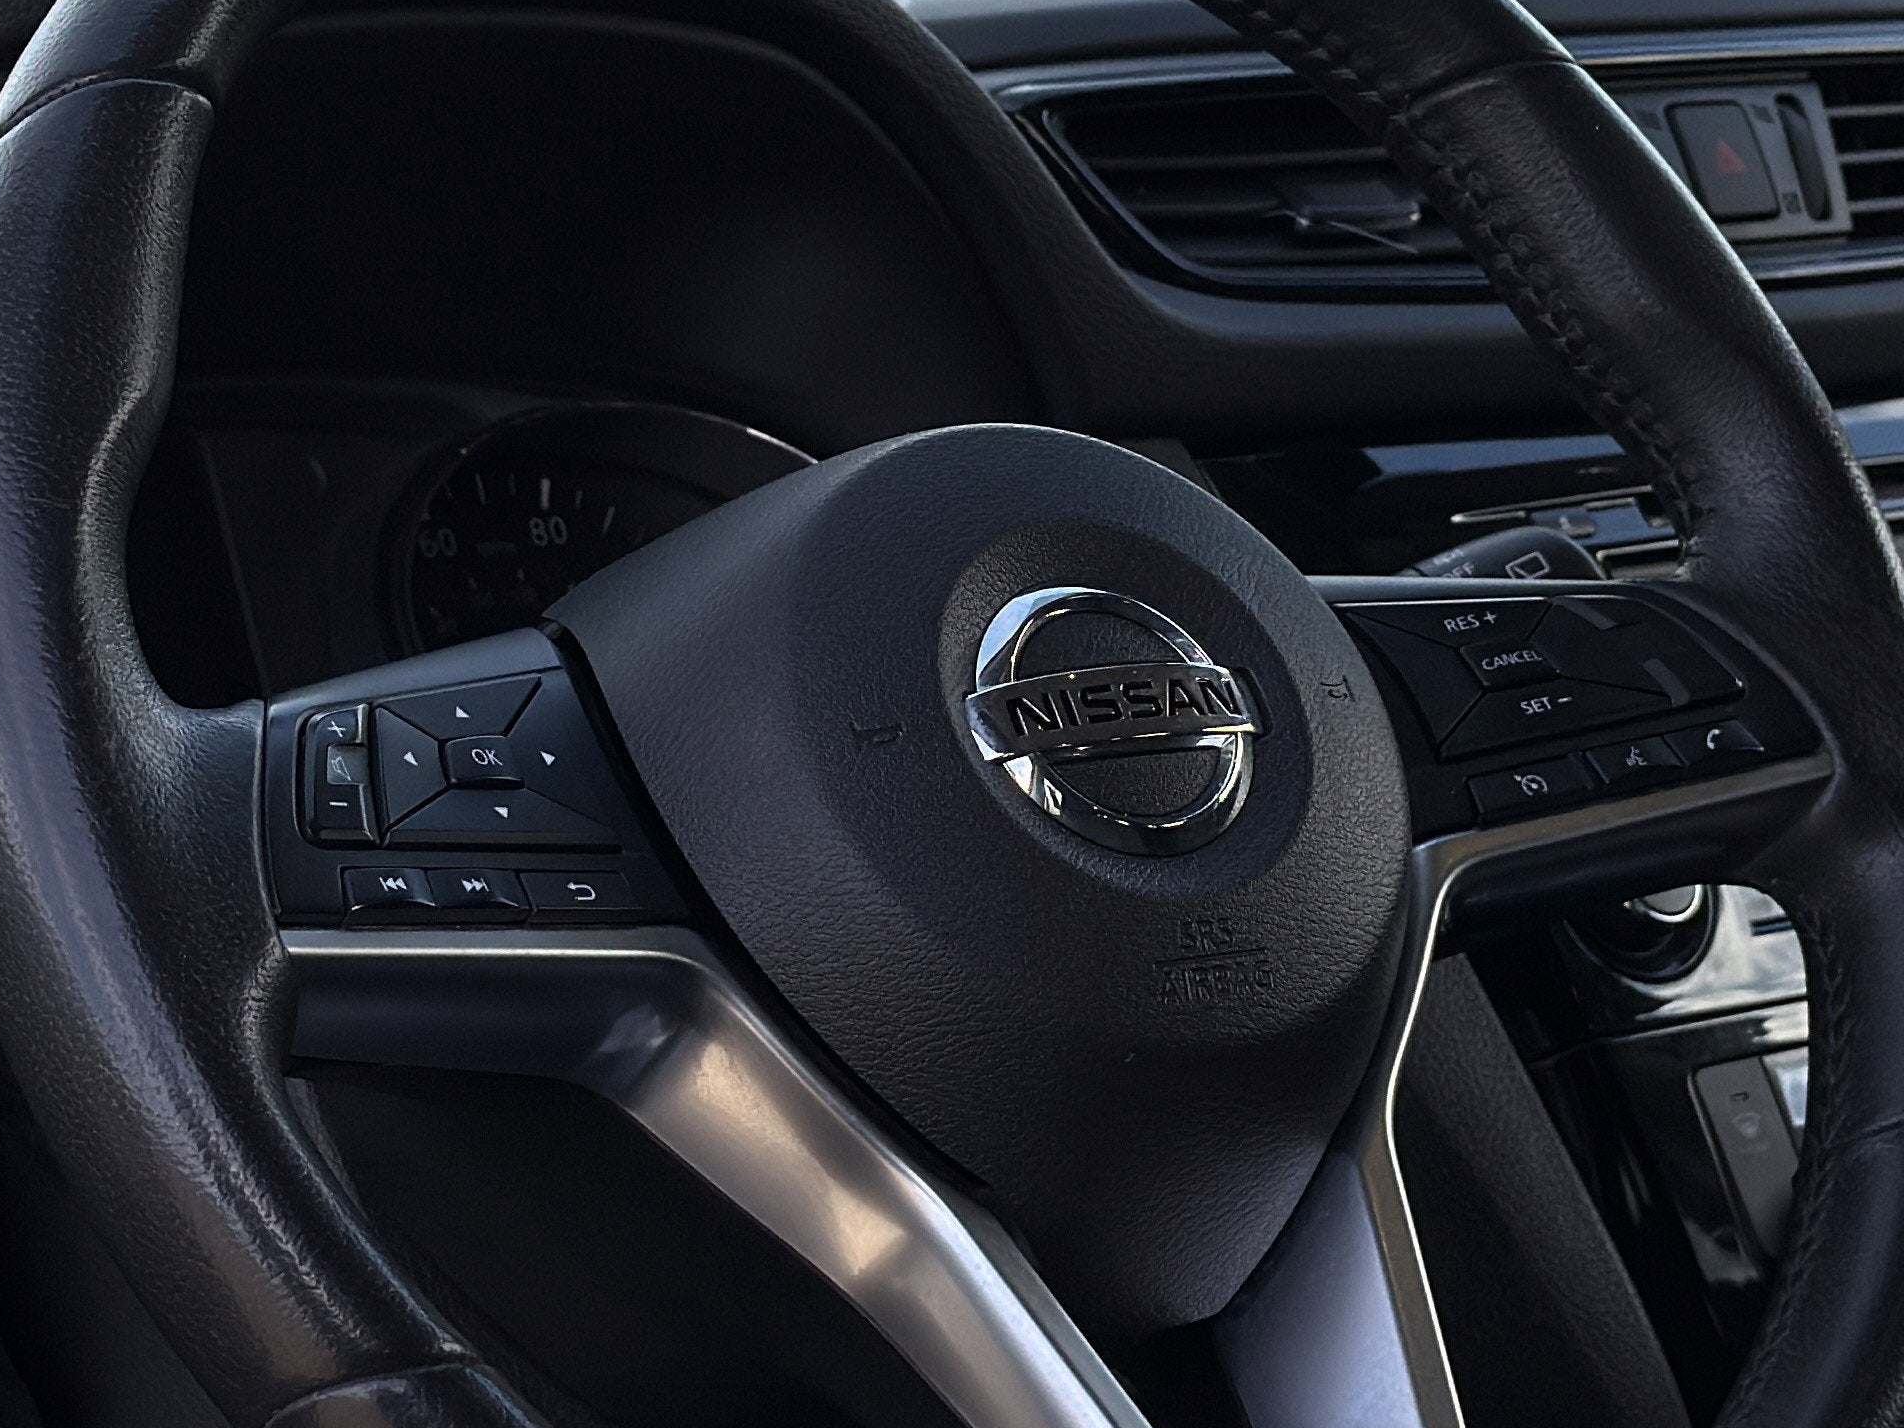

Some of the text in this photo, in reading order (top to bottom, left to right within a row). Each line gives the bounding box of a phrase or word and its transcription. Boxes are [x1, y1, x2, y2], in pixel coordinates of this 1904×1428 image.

[528, 514, 570, 549] 80
[1443, 613, 1479, 634] RES
[1481, 648, 1545, 672] CANCEL
[1003, 676, 1240, 739] NISSAN
[1519, 696, 1551, 716] SET
[470, 747, 504, 767] OK
